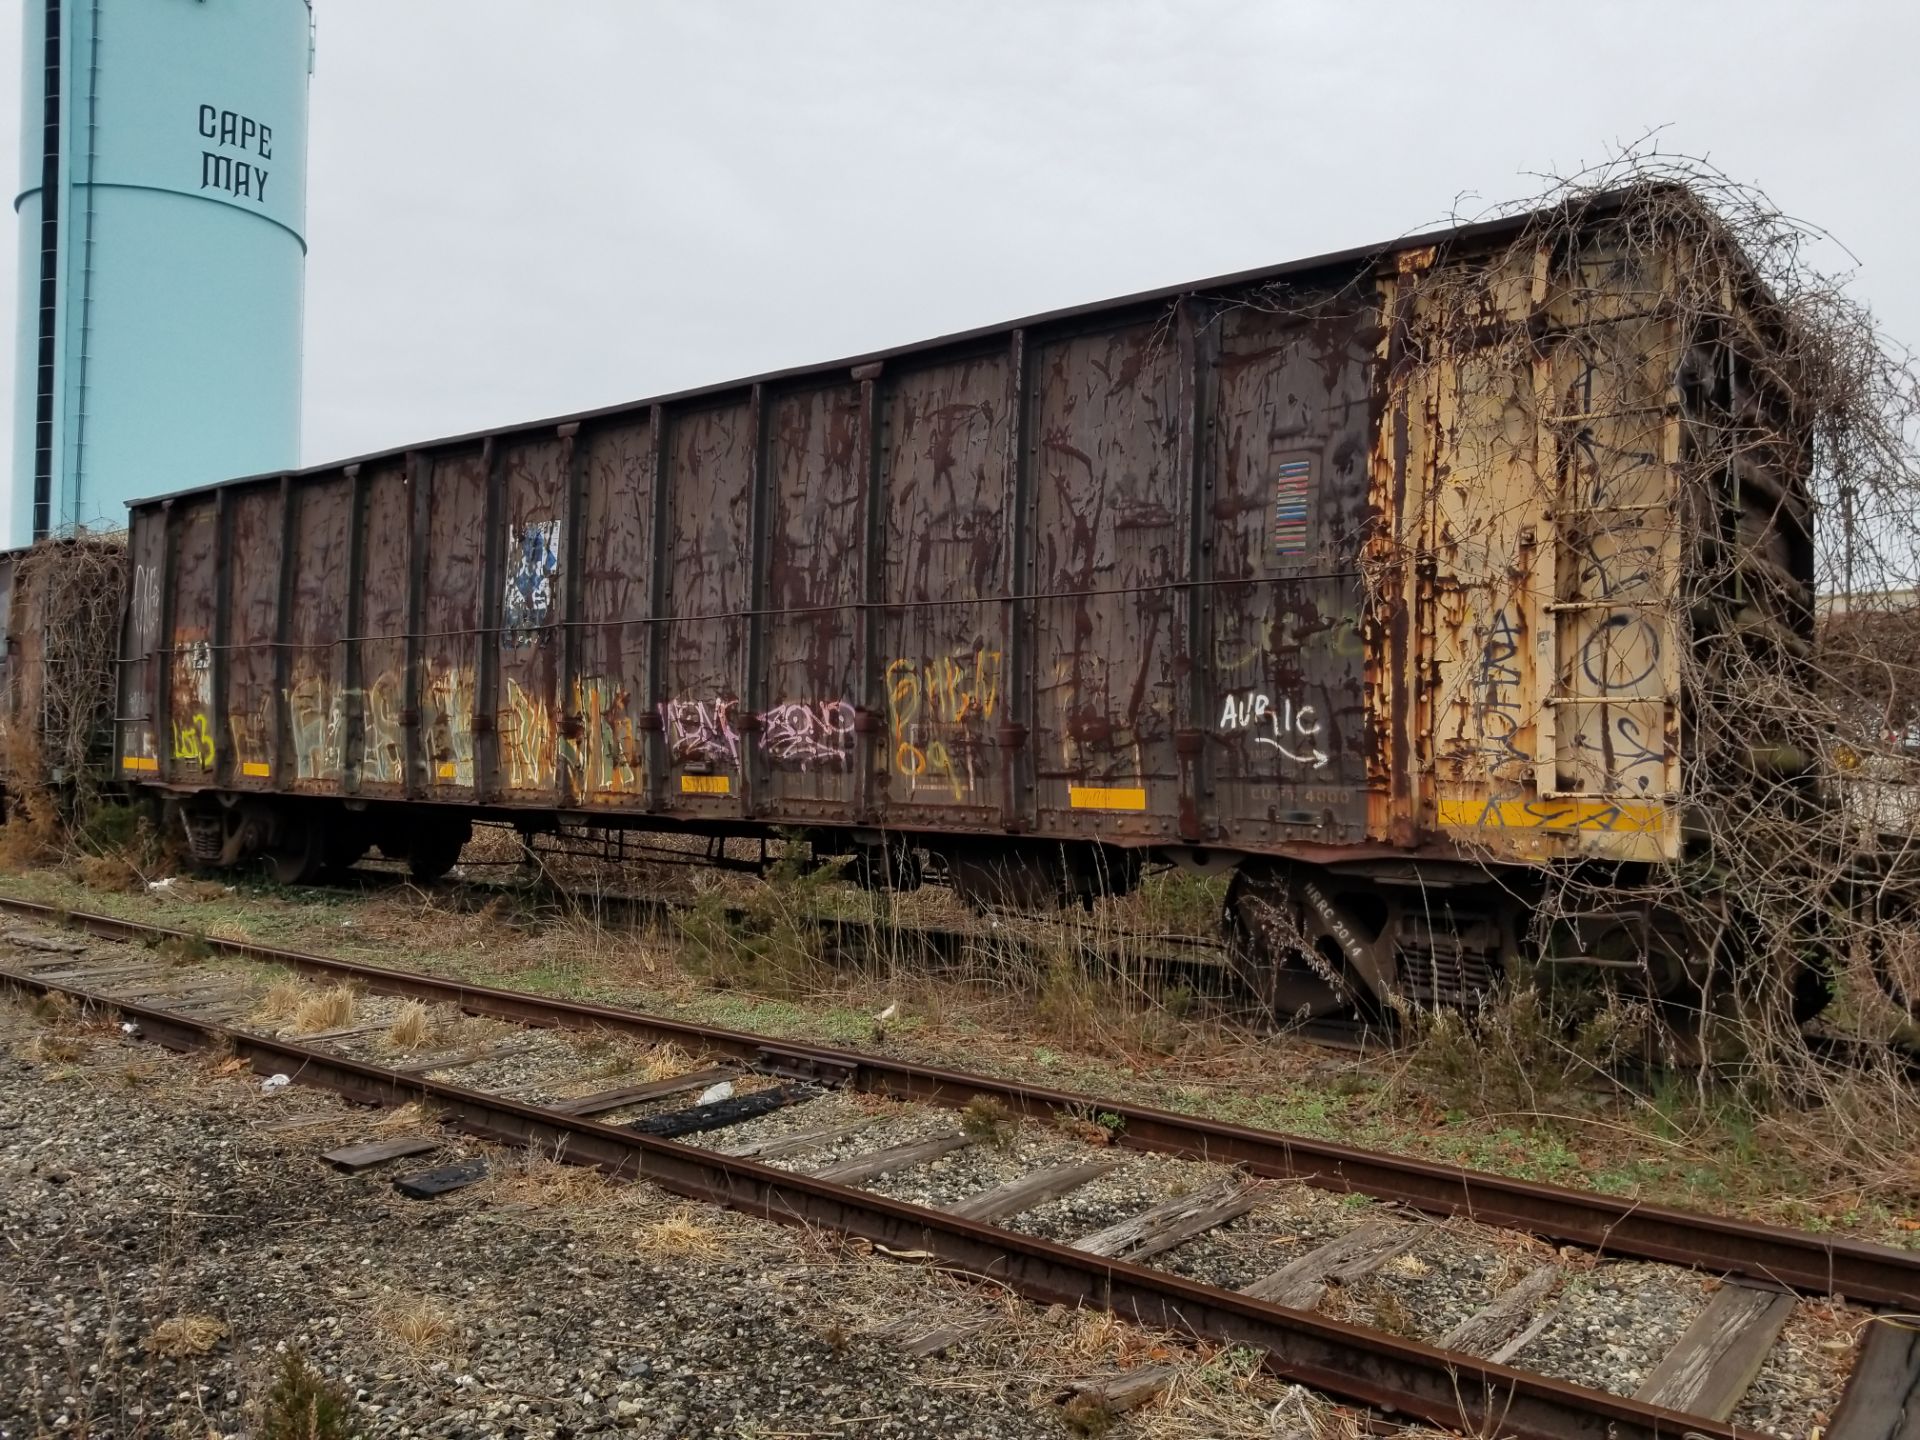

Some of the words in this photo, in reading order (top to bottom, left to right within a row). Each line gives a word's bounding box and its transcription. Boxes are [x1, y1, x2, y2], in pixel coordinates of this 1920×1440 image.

[199, 104, 272, 160] CAPE
[201, 151, 268, 203] MAY
[1332, 921, 1363, 957] 2014
